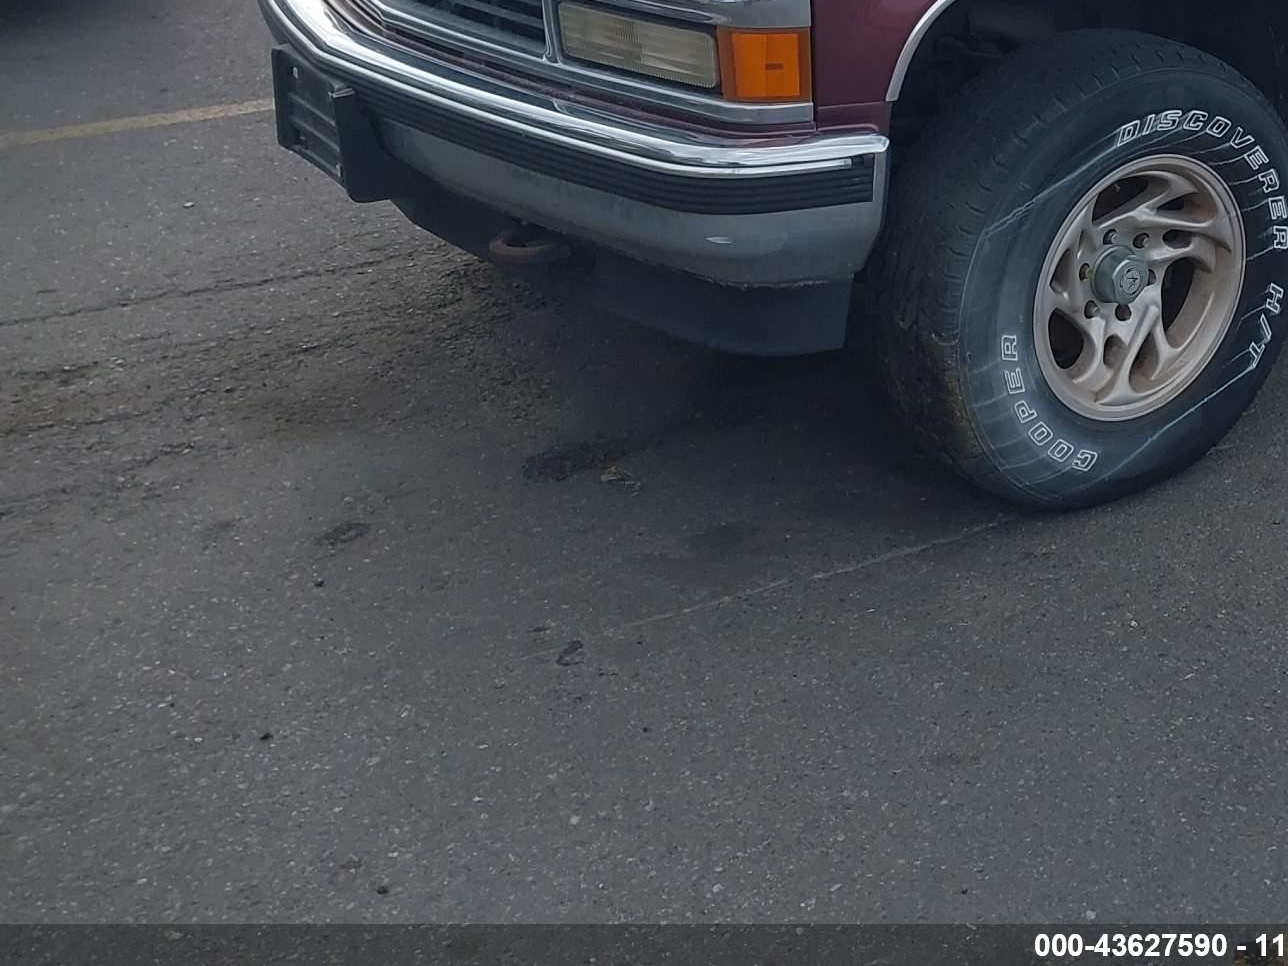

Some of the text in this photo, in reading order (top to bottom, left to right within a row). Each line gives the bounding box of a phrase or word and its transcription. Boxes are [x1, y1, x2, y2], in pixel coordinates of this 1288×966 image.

[1117, 110, 1288, 368] DISCOVERER H/T
[1001, 335, 1098, 472] COOPER
